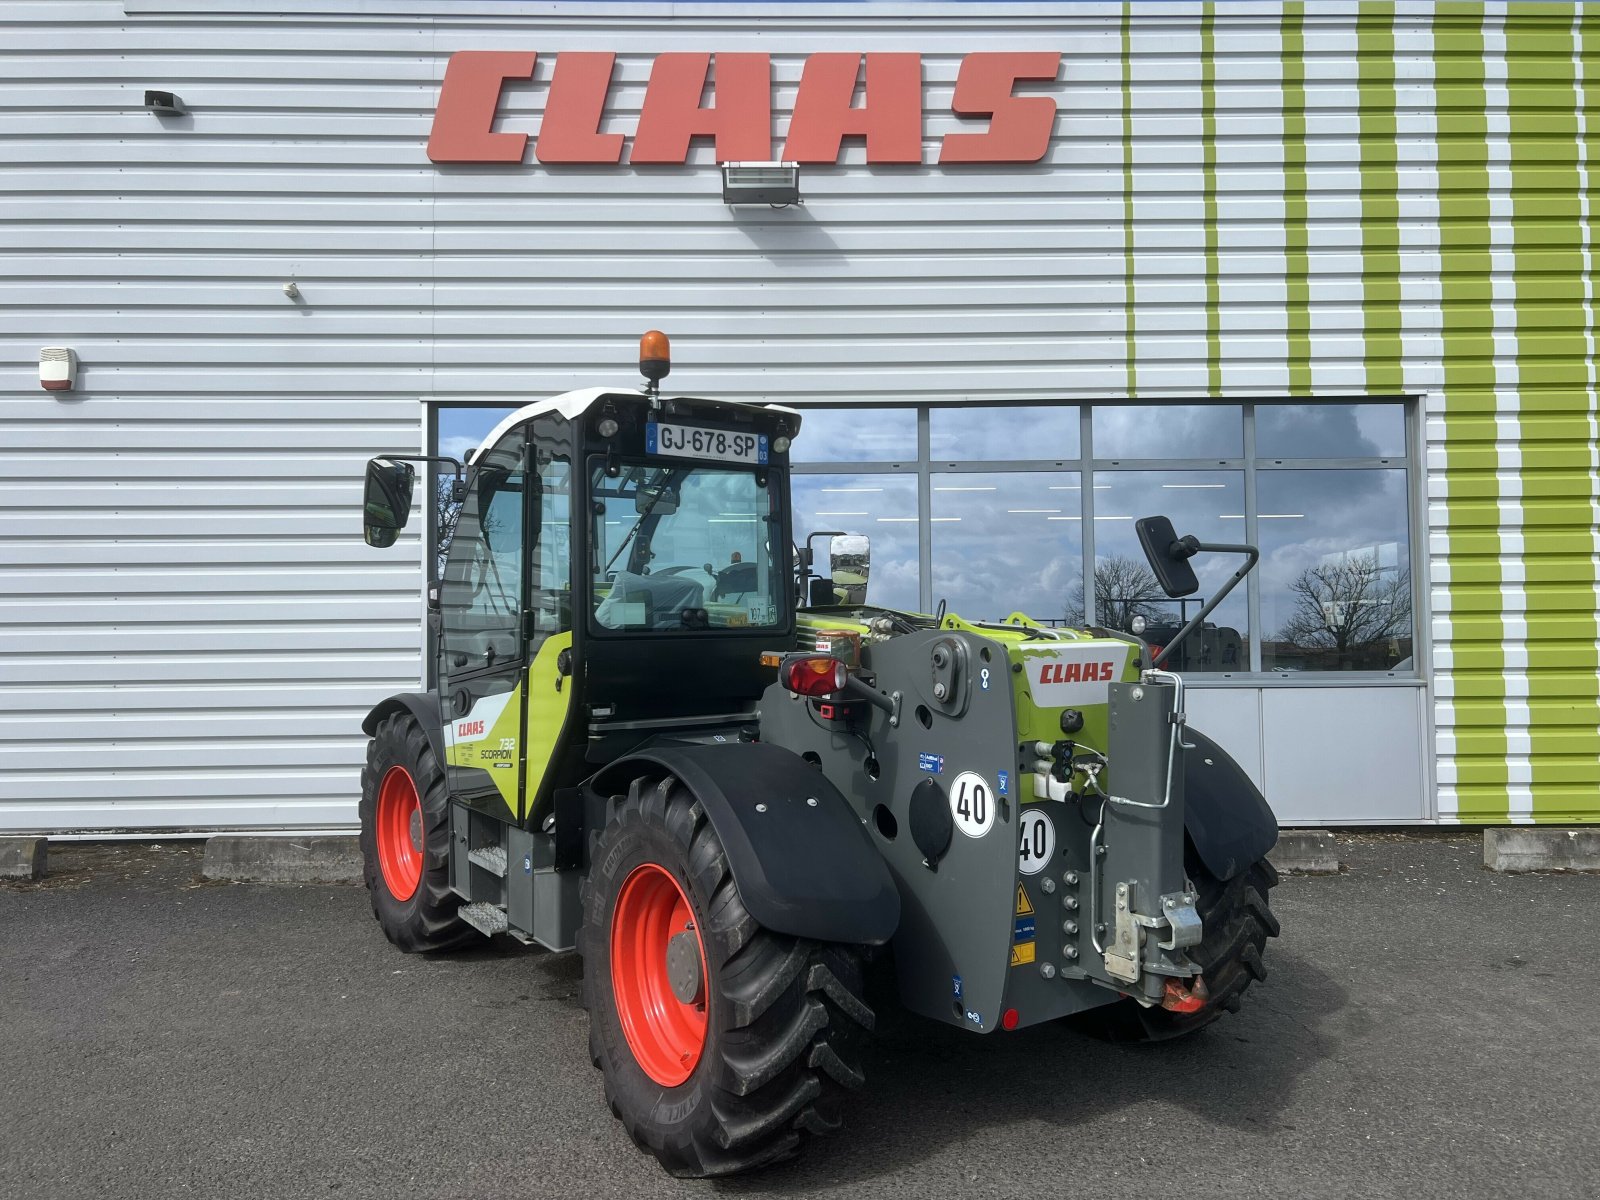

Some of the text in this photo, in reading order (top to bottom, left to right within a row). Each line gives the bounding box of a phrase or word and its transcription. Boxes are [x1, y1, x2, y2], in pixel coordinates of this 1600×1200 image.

[427, 51, 1062, 165] CLAAS
[661, 427, 755, 457] GJ-678-SP
[1040, 661, 1114, 684] CLAAS
[458, 720, 484, 737] CLAAS
[481, 749, 512, 759] SCORPION
[500, 738, 515, 750] 732
[957, 782, 986, 824] 40
[1020, 819, 1046, 861] 40
